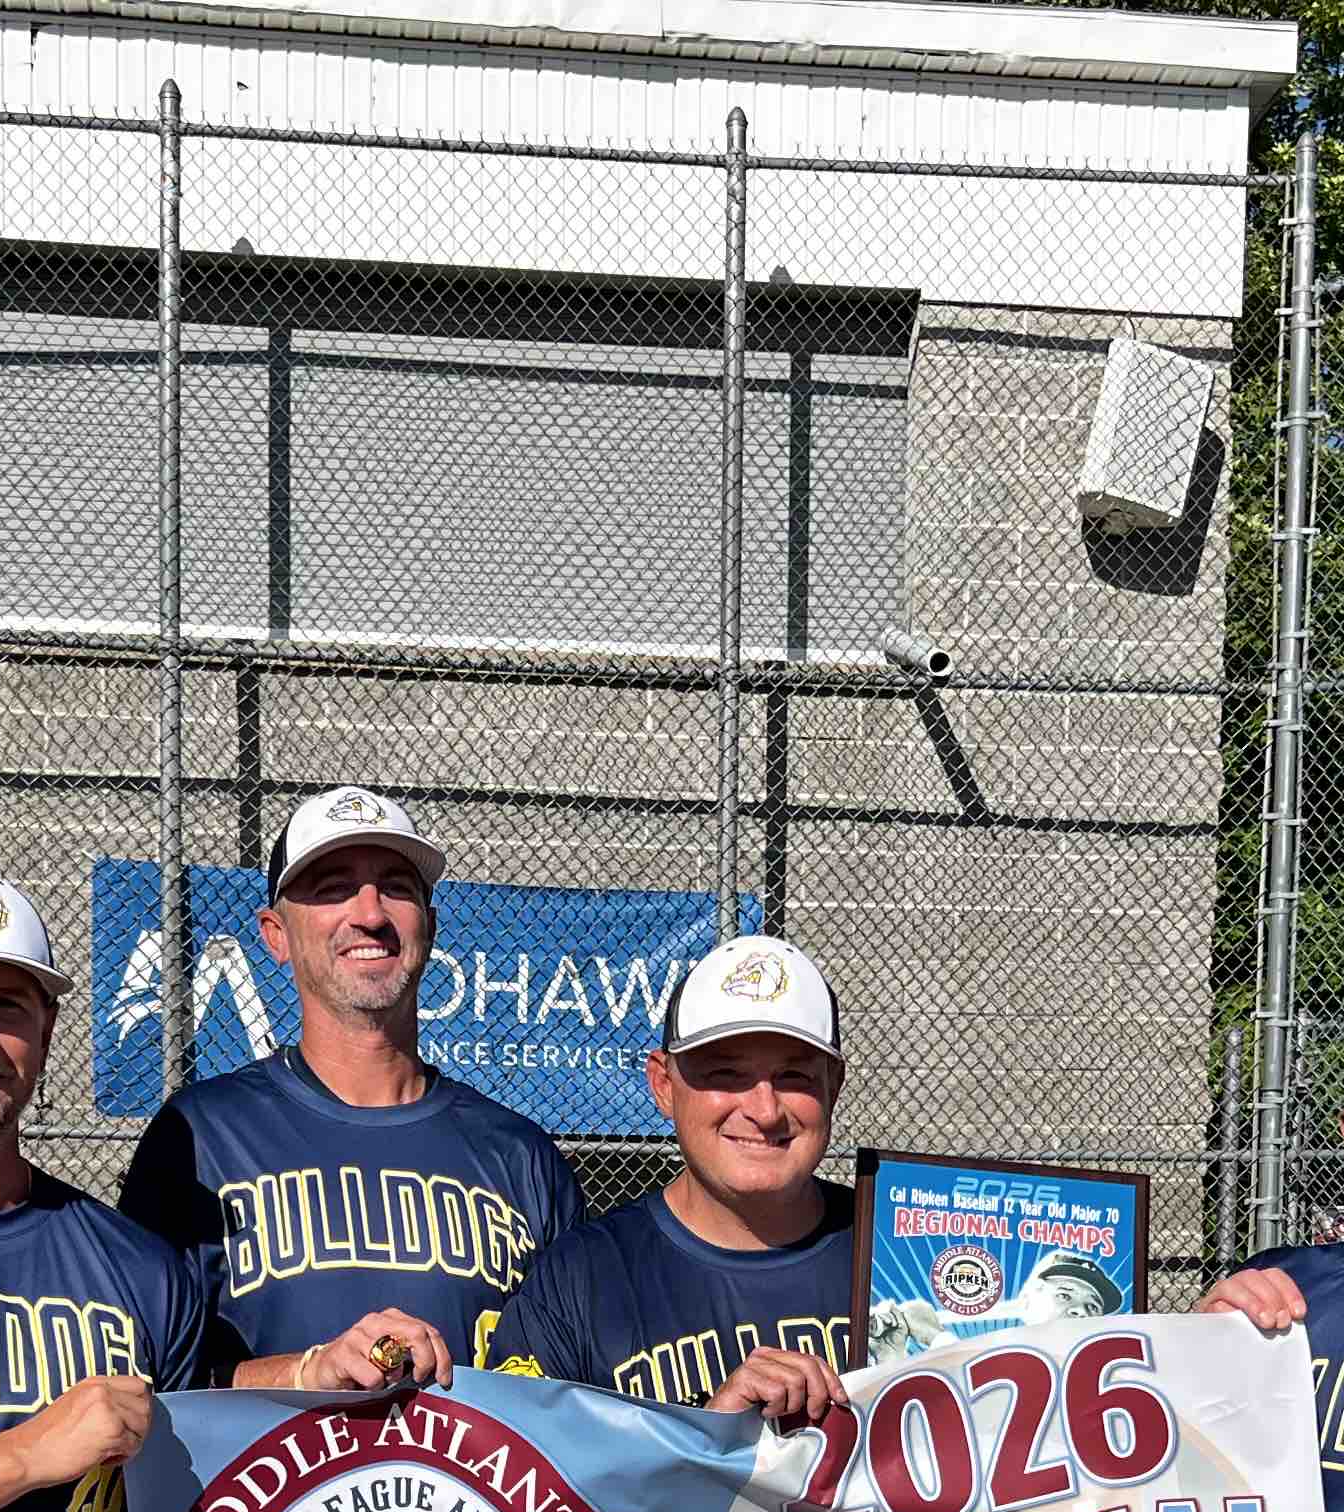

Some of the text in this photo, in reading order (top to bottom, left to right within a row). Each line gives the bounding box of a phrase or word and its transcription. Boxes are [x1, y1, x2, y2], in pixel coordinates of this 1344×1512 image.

[417, 948, 703, 1028] OHAW
[418, 1040, 650, 1072] NCE SERVICES
[889, 1186, 1120, 1225] Cal Ripken Baseball 12 Year Old Major 70
[952, 1176, 1061, 1206] 2026
[894, 1206, 1116, 1257] REGIONAL CHAMPS
[945, 1273, 989, 1289] RIPKEN
[943, 1298, 989, 1315] REGION
